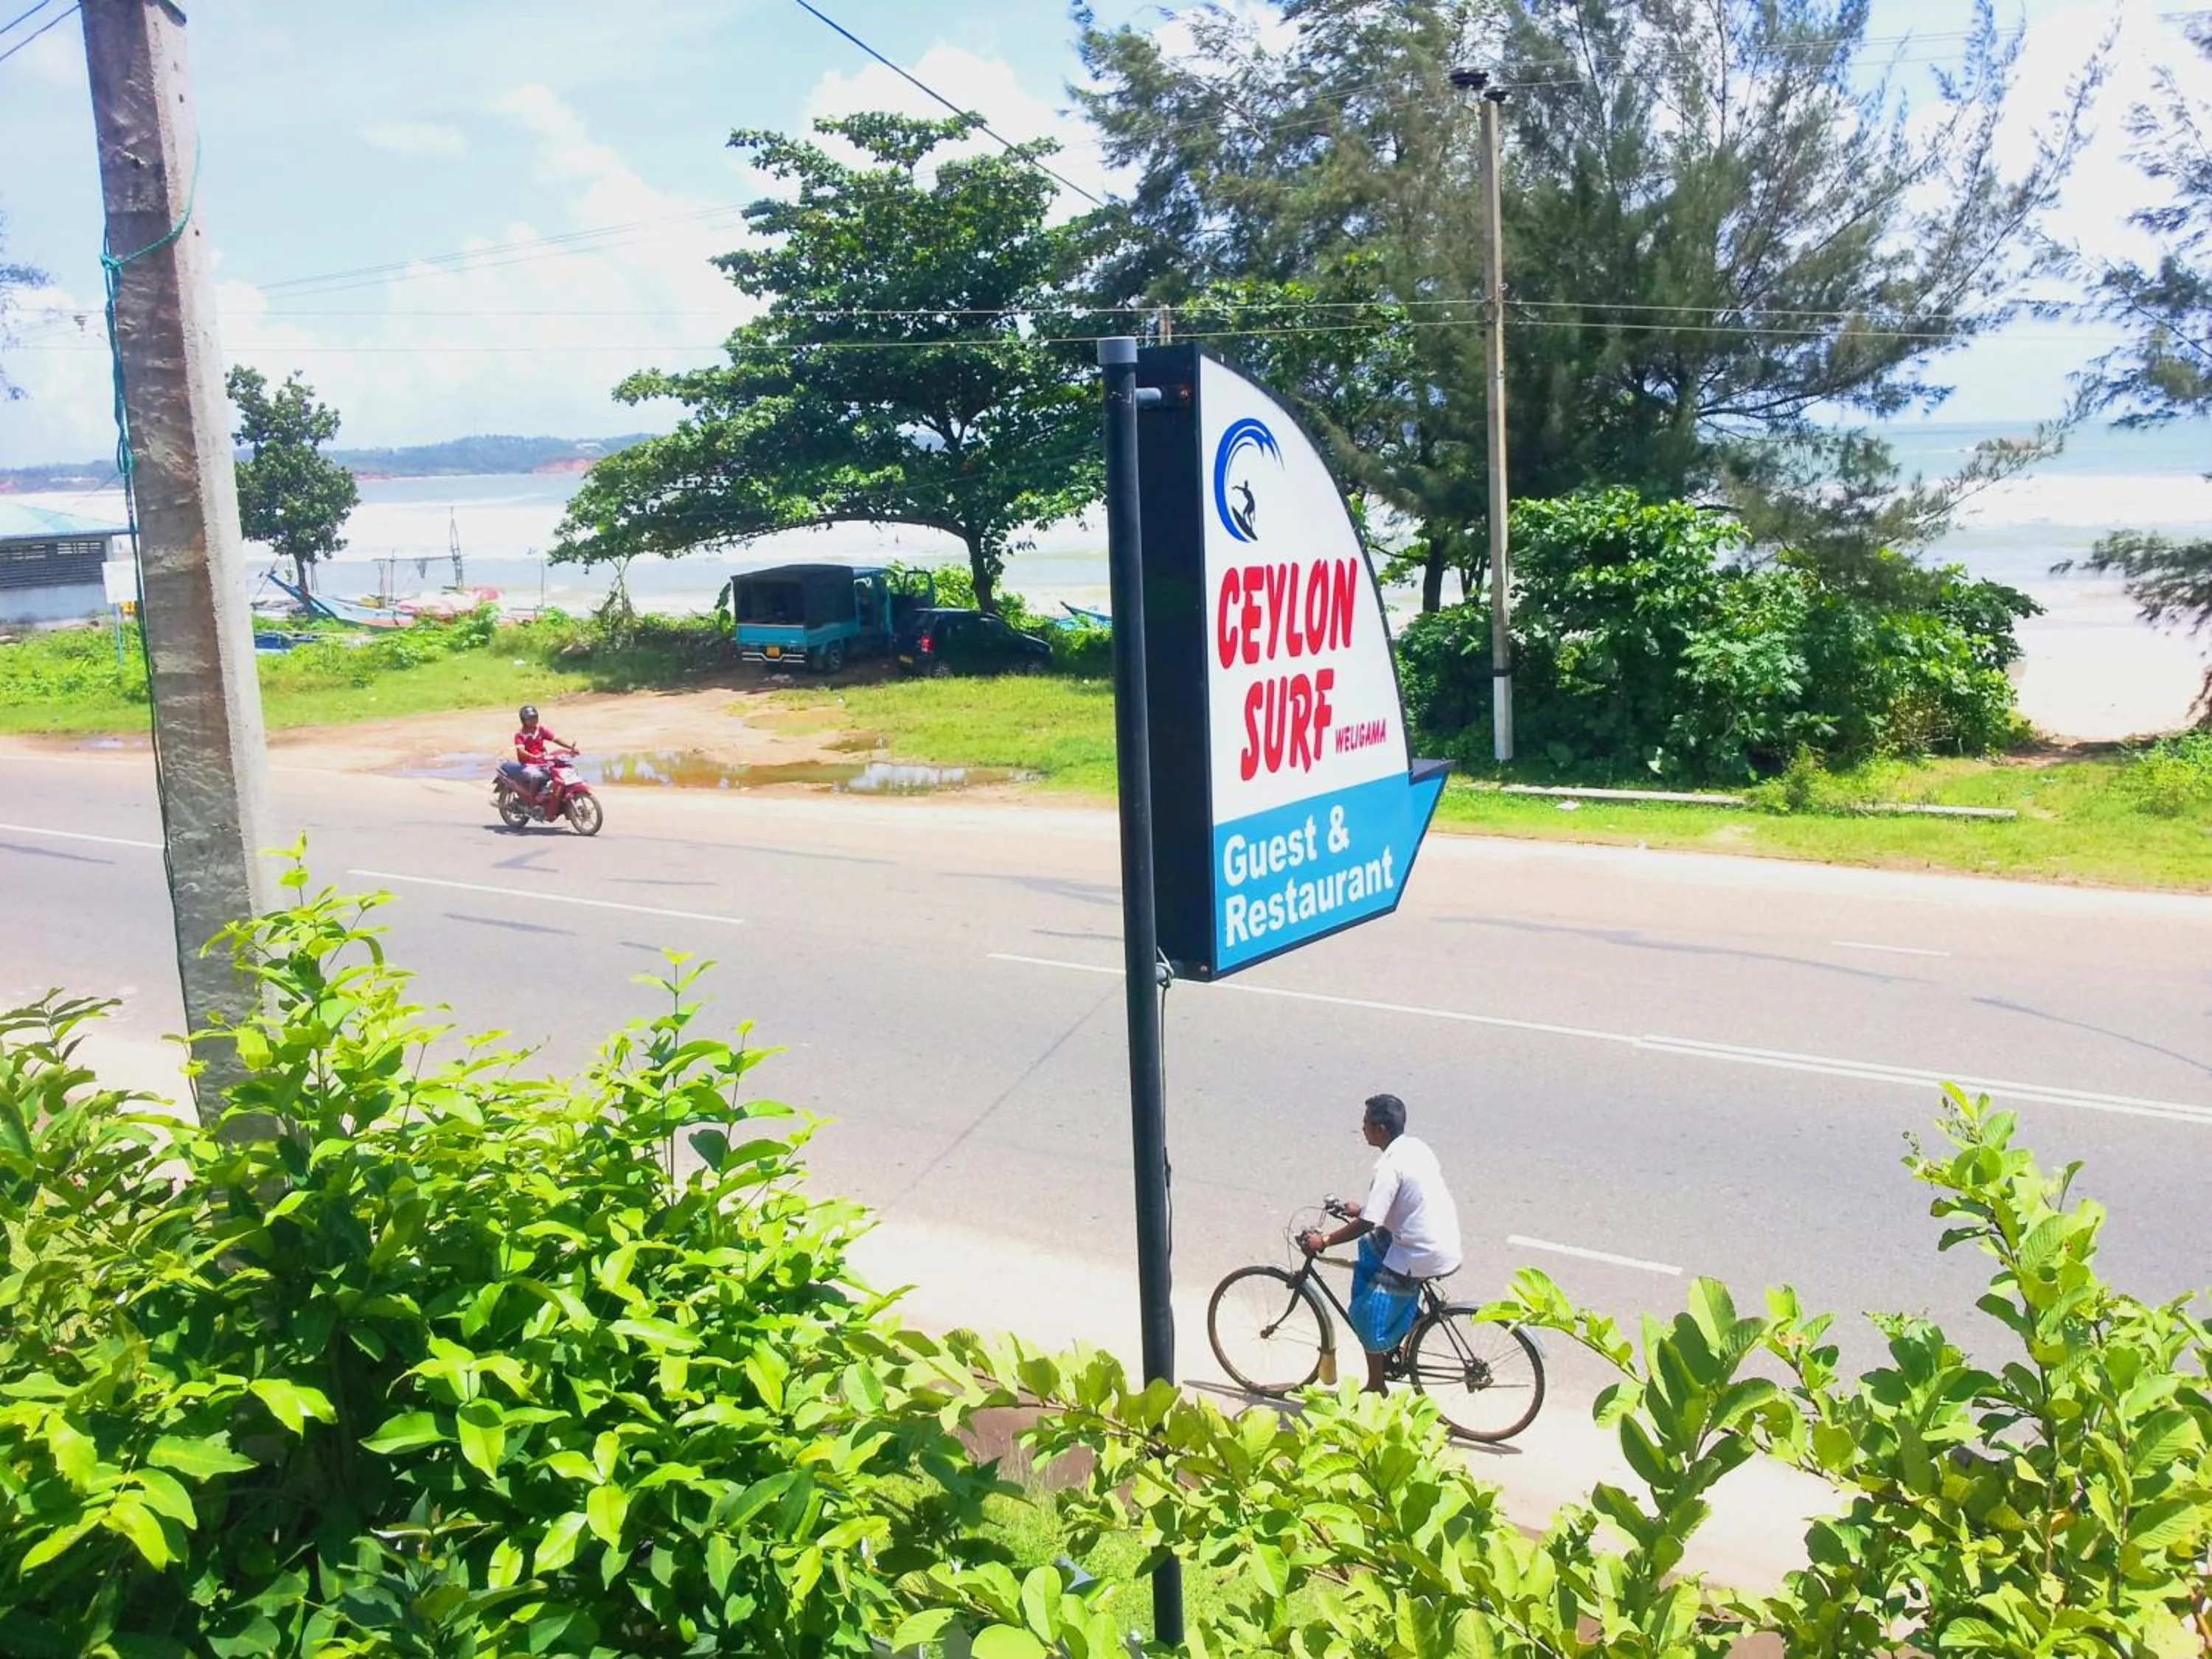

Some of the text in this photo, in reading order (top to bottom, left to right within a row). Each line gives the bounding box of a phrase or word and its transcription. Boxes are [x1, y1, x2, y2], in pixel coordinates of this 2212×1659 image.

[1218, 558, 1357, 669] CEYLON
[1241, 669, 1335, 781] SURF
[1335, 719, 1386, 754] WELIGAMA
[1223, 805, 1349, 886] Guest &
[1225, 846, 1394, 947] Restaurant
